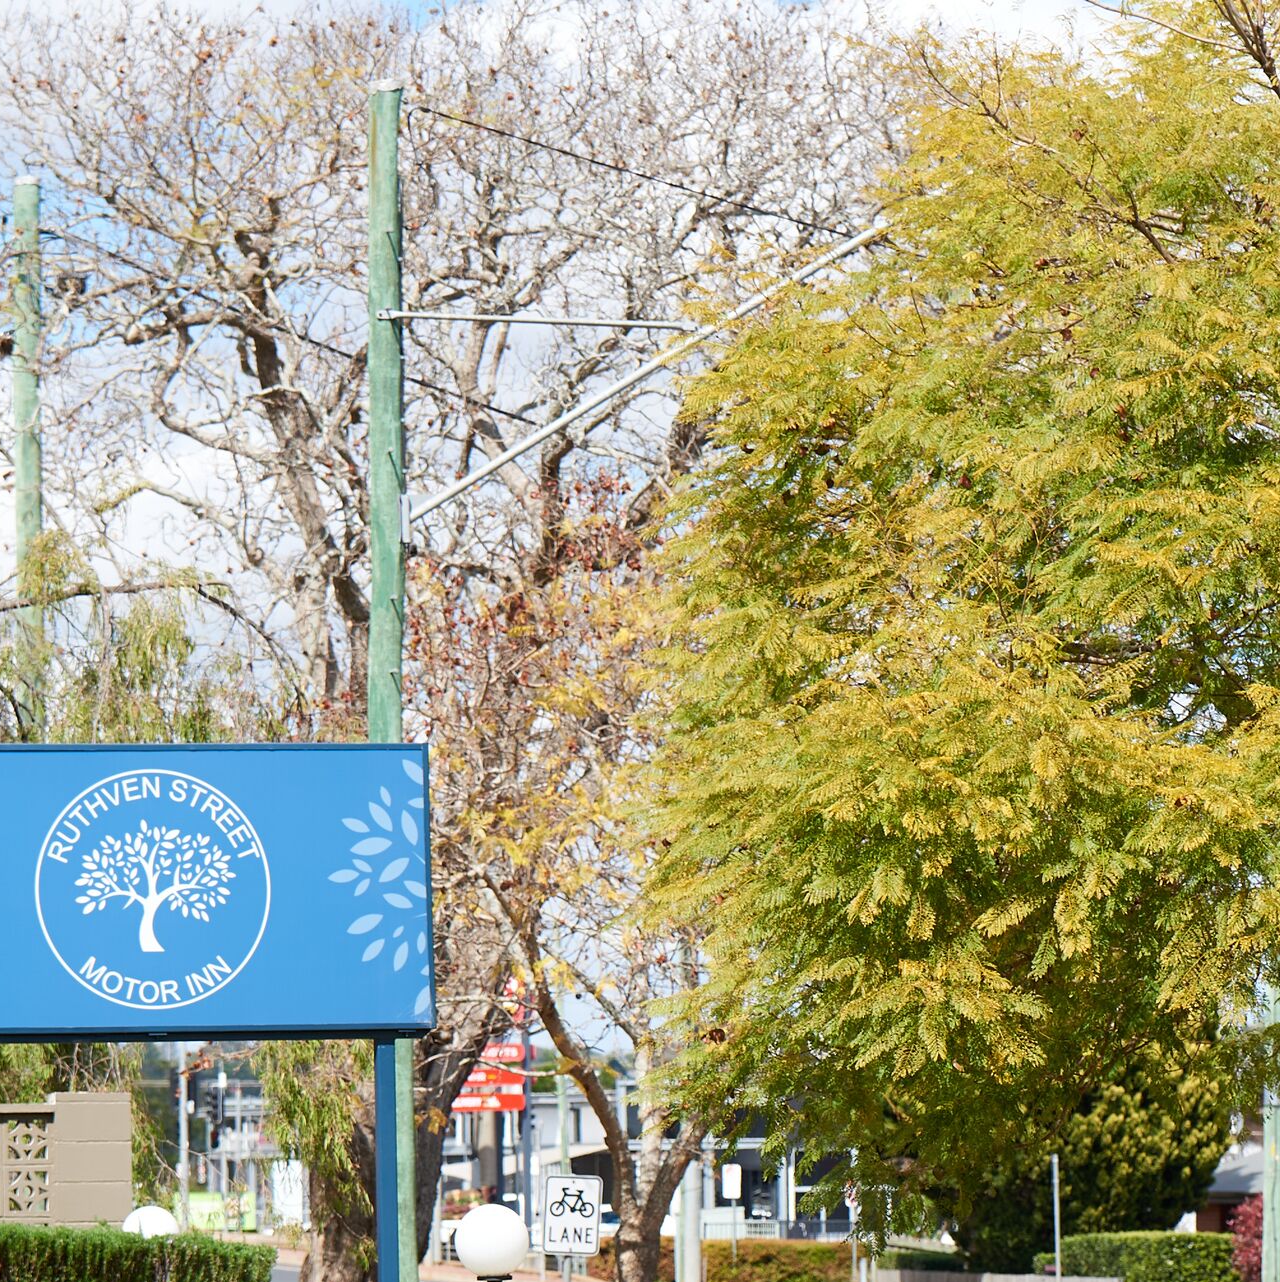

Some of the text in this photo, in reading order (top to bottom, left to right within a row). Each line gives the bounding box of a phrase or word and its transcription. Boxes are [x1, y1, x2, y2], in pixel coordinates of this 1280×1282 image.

[48, 776, 261, 864] RUTHVEN STREET
[79, 955, 233, 1004] MOTOR INN
[549, 1226, 593, 1244] LANE
